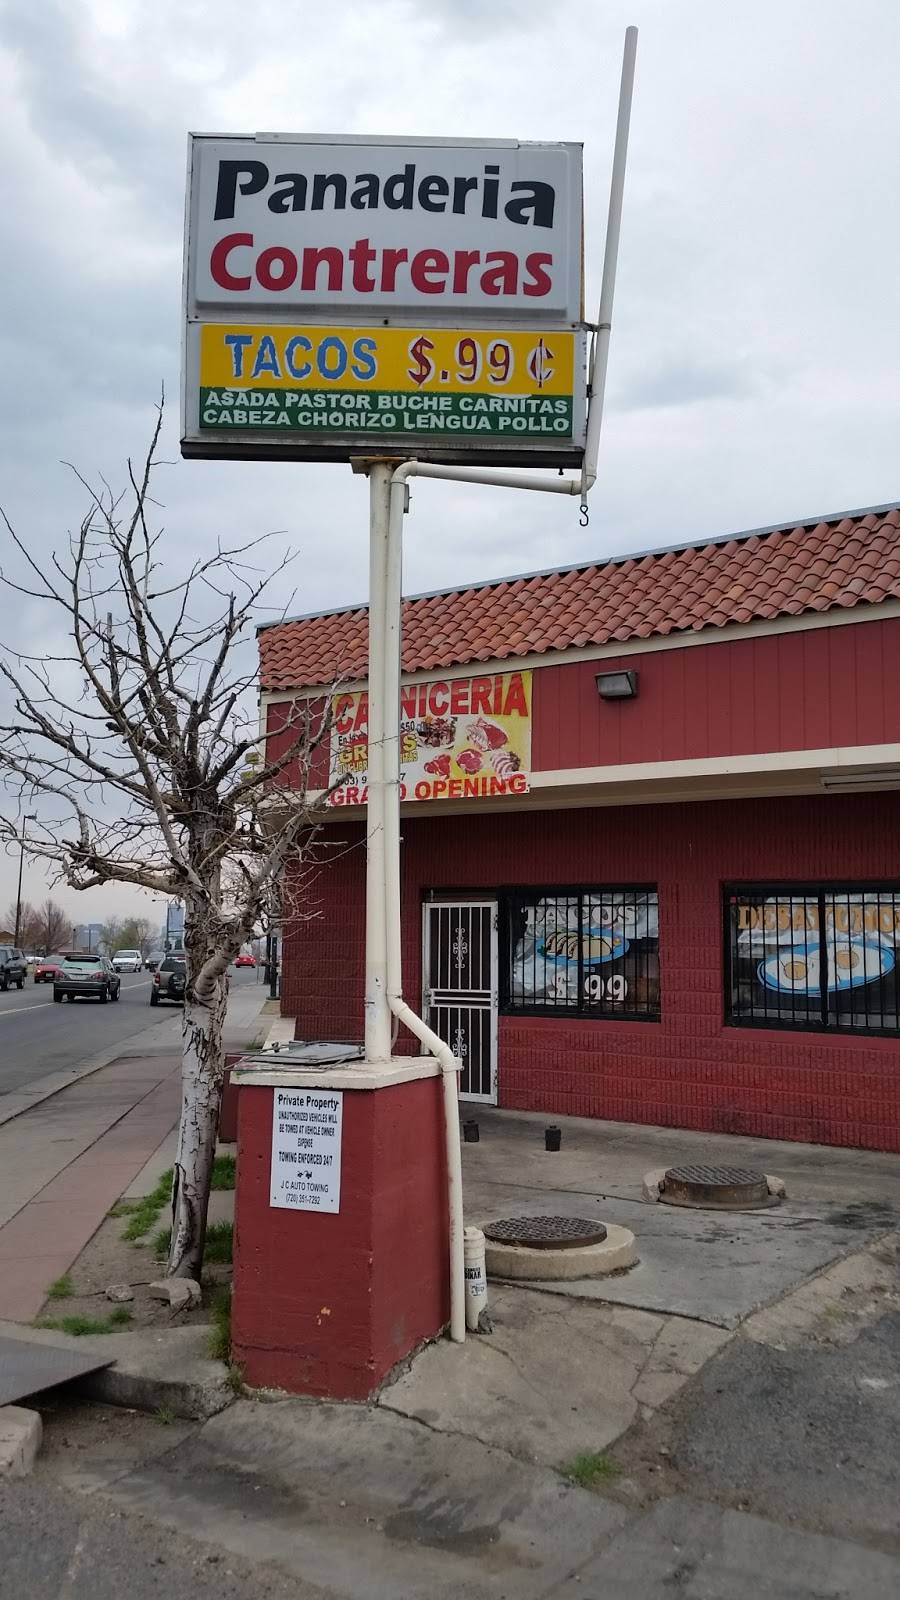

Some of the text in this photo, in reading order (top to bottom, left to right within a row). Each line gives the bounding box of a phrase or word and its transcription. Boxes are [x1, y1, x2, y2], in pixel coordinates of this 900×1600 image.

[213, 159, 556, 229] Panaderia
[209, 232, 554, 297] Contreras
[224, 334, 378, 382] TACOS
[205, 392, 568, 414] ASADA PASTOR BUCHE CARNITAS
[202, 409, 570, 433] CABEZA CHORIZO LENGUA POLLO
[335, 673, 529, 734] CANICERIA
[415, 773, 527, 801] OPENING
[521, 904, 638, 926] TACOS
[278, 1094, 338, 1111] Private Property
[309, 1113, 328, 1123] VEHICLES
[279, 1151, 333, 1167] TOWING ENFORCED 24/7
[291, 1181, 306, 1191] AUTO
[307, 1182, 329, 1193] TOWING
